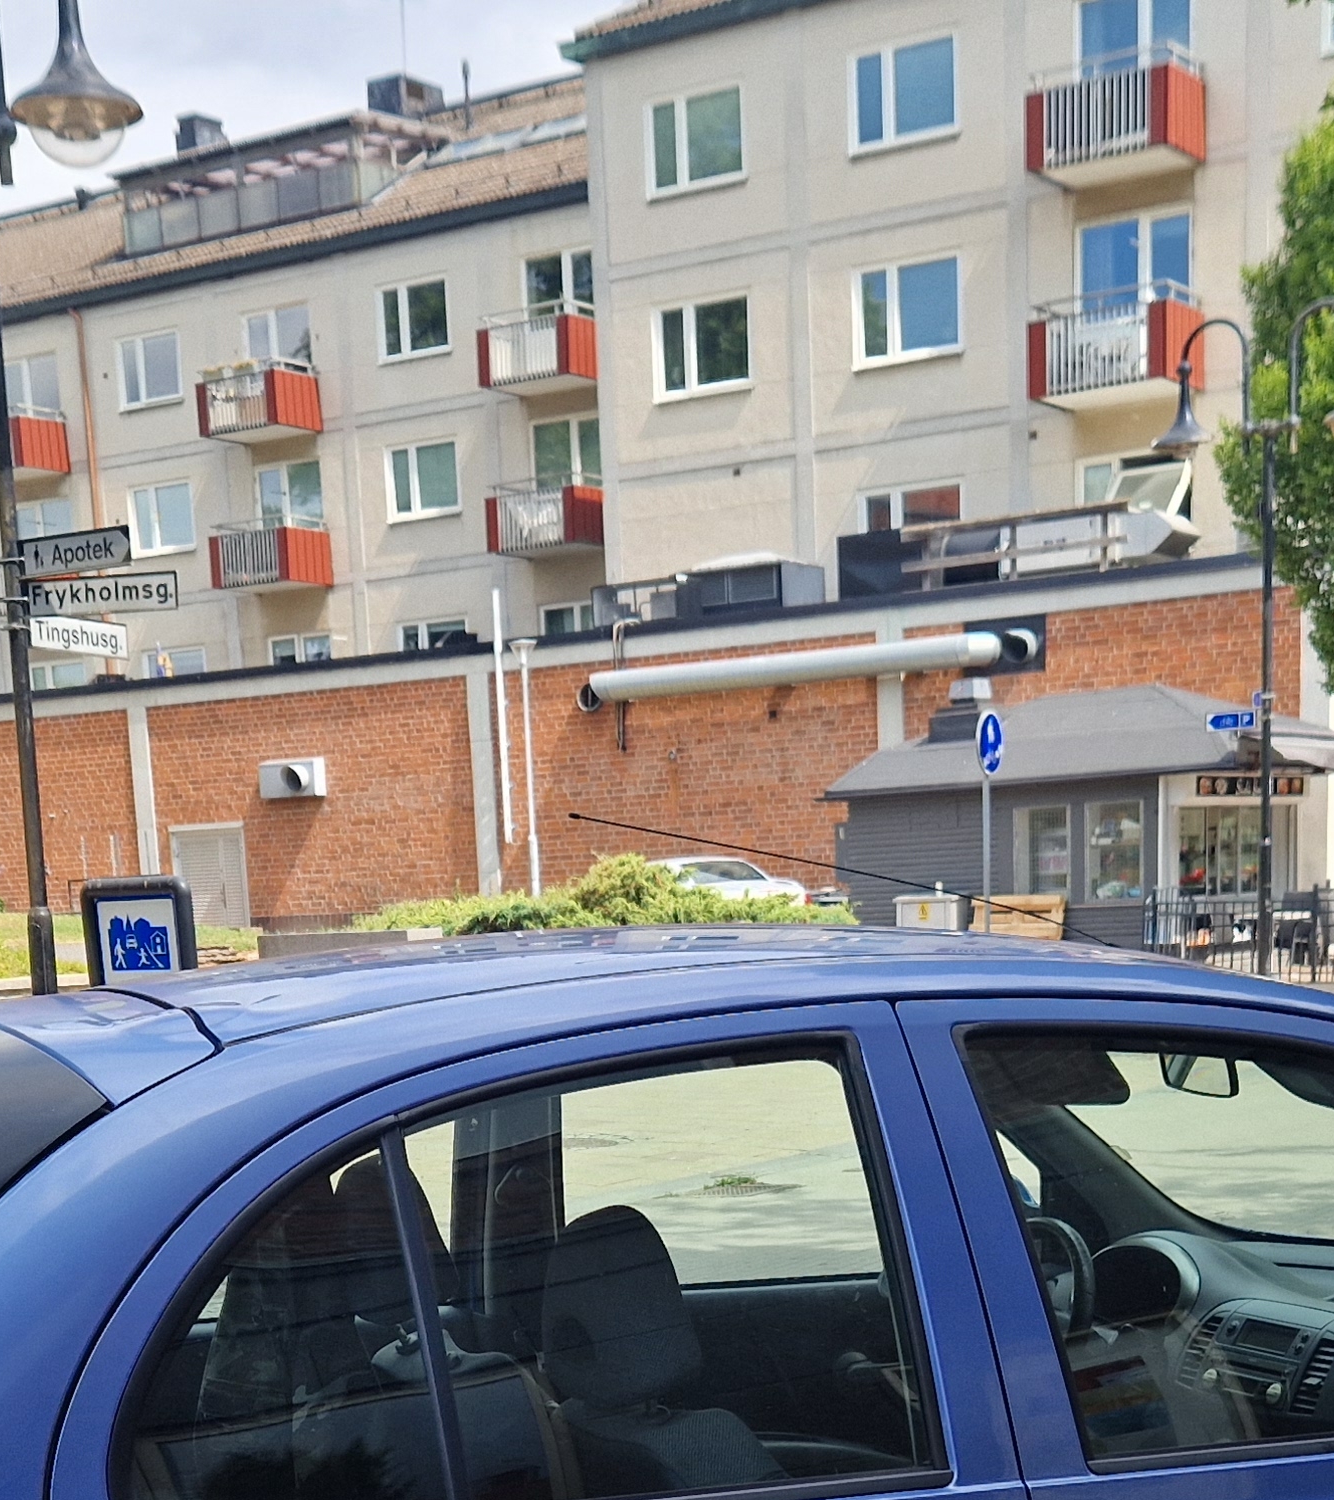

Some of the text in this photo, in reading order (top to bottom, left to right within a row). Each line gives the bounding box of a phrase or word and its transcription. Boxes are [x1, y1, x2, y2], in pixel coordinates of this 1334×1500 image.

[52, 537, 114, 567] Apotek
[32, 580, 173, 609] Frykholmsg.
[35, 620, 123, 653] Tingshusg.
